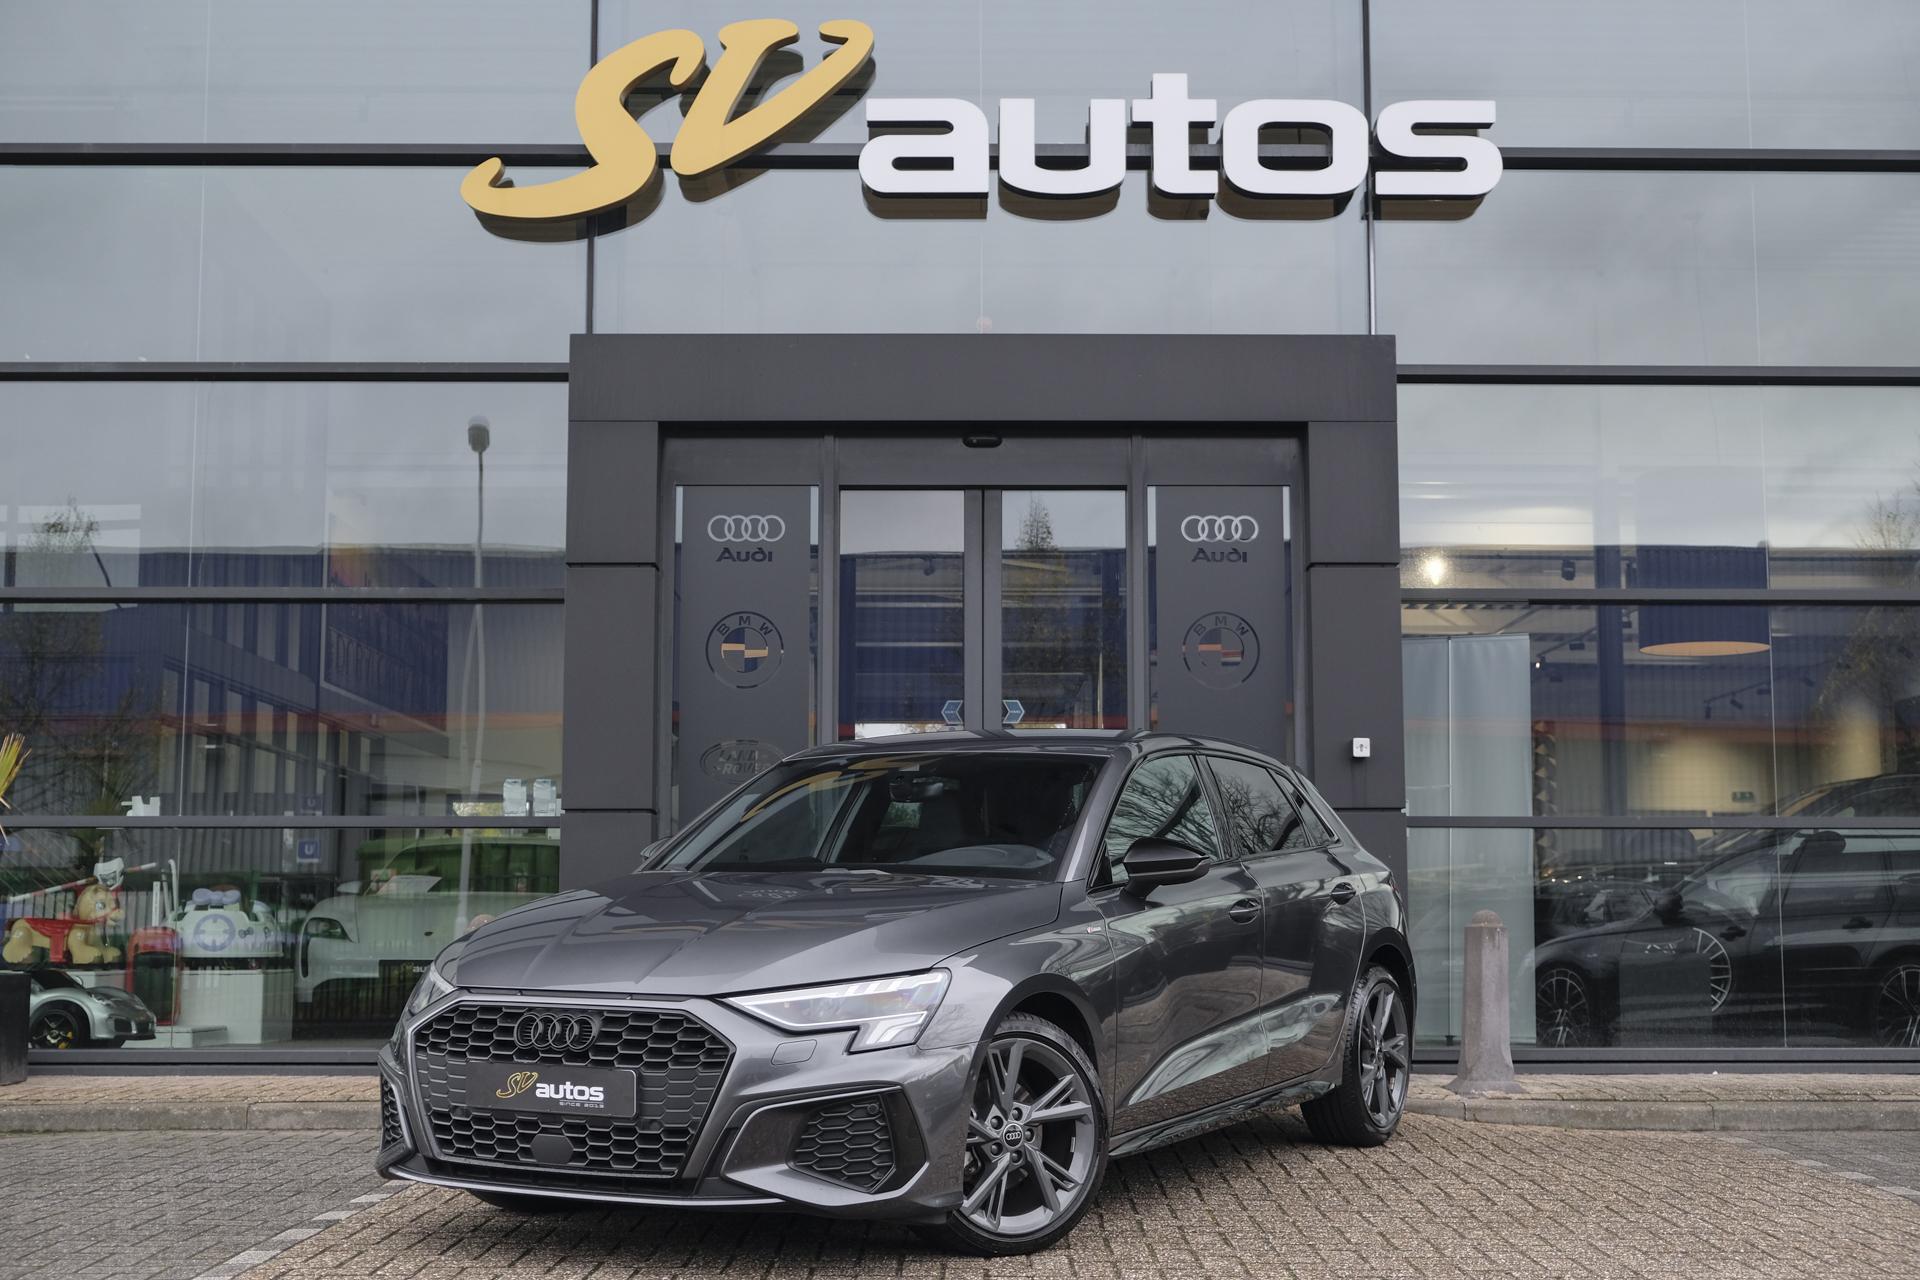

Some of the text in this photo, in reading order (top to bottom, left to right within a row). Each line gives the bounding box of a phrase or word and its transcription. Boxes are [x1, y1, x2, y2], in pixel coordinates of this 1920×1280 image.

[460, 18, 1504, 219] SV autos
[715, 547, 773, 562] Audi
[1191, 548, 1248, 563] Audi
[717, 616, 773, 636] BMW
[1194, 616, 1249, 637] BMW
[536, 1081, 604, 1101] autos
